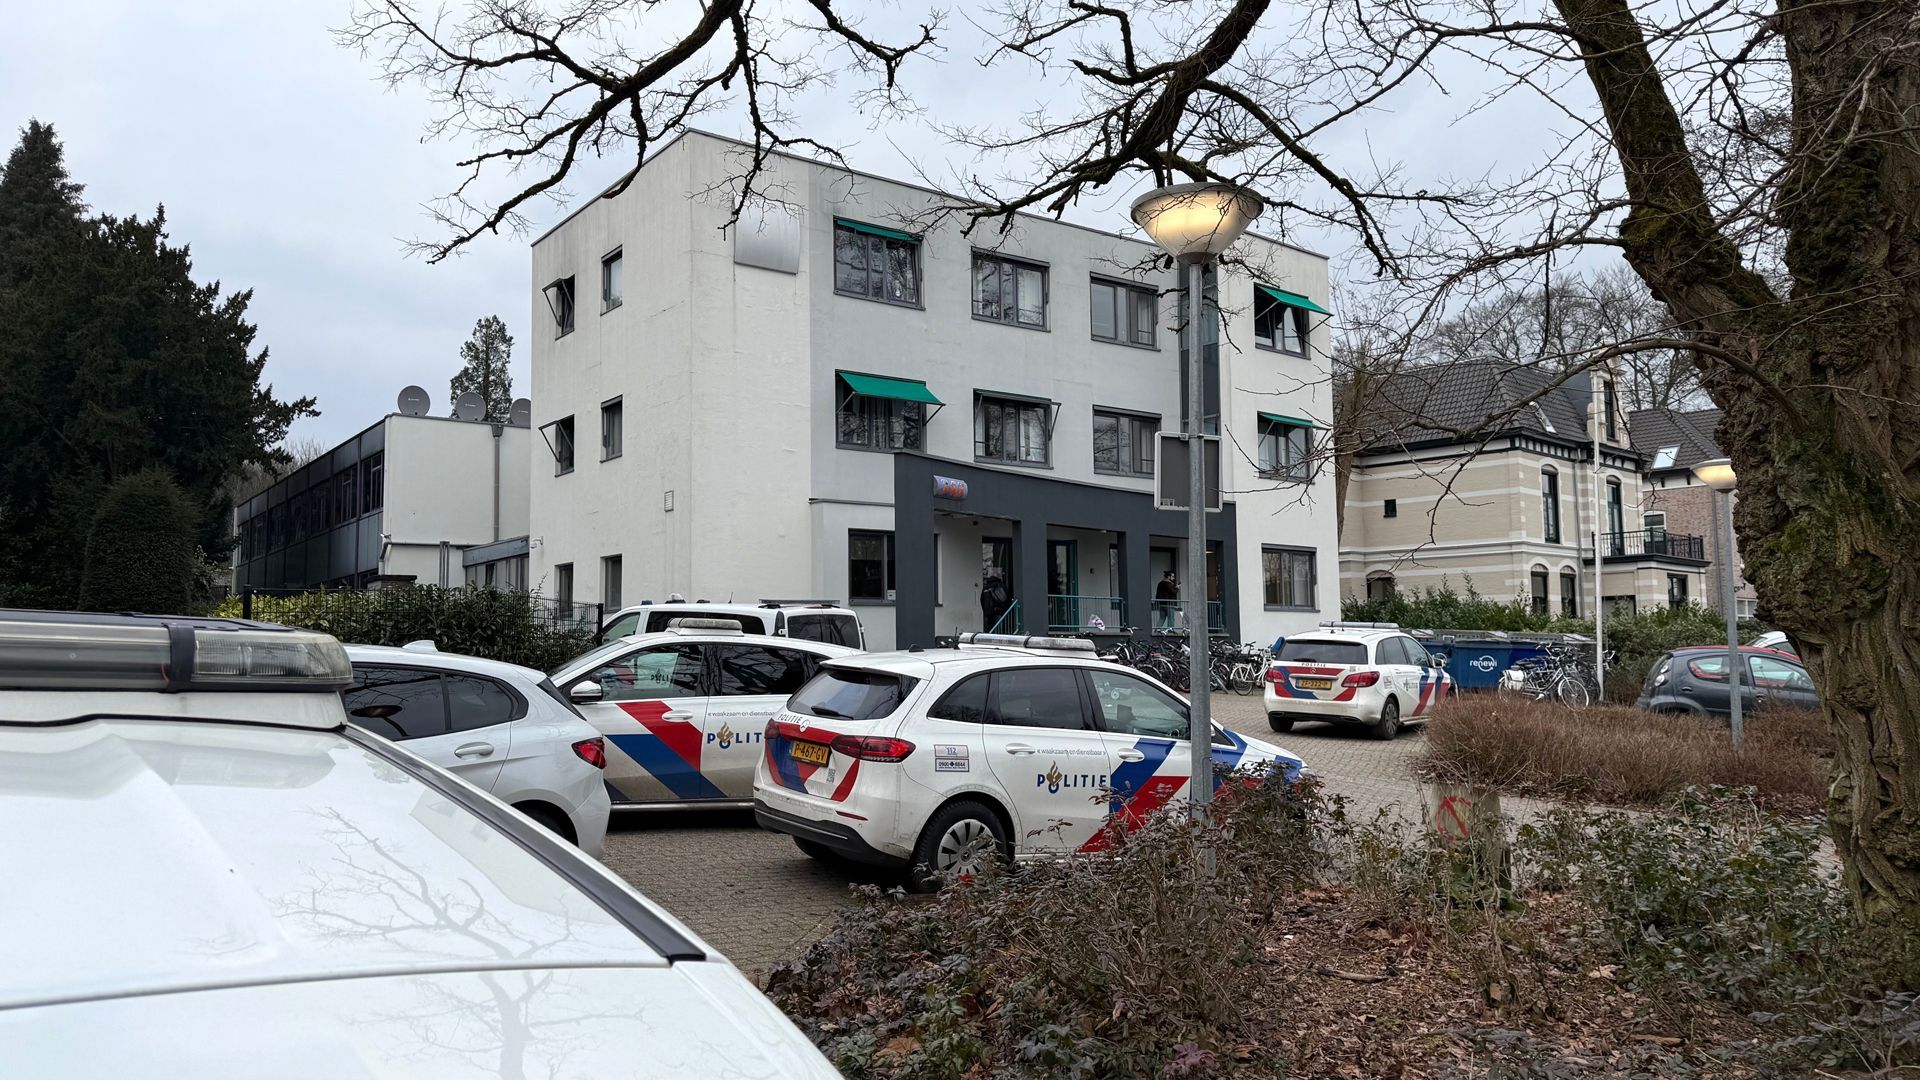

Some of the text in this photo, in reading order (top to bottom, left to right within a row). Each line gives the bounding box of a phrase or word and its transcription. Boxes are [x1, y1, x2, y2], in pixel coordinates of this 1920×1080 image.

[777, 713, 803, 723] POLITIE
[707, 732, 762, 749] POLIT
[1037, 773, 1107, 794] POLITIE
